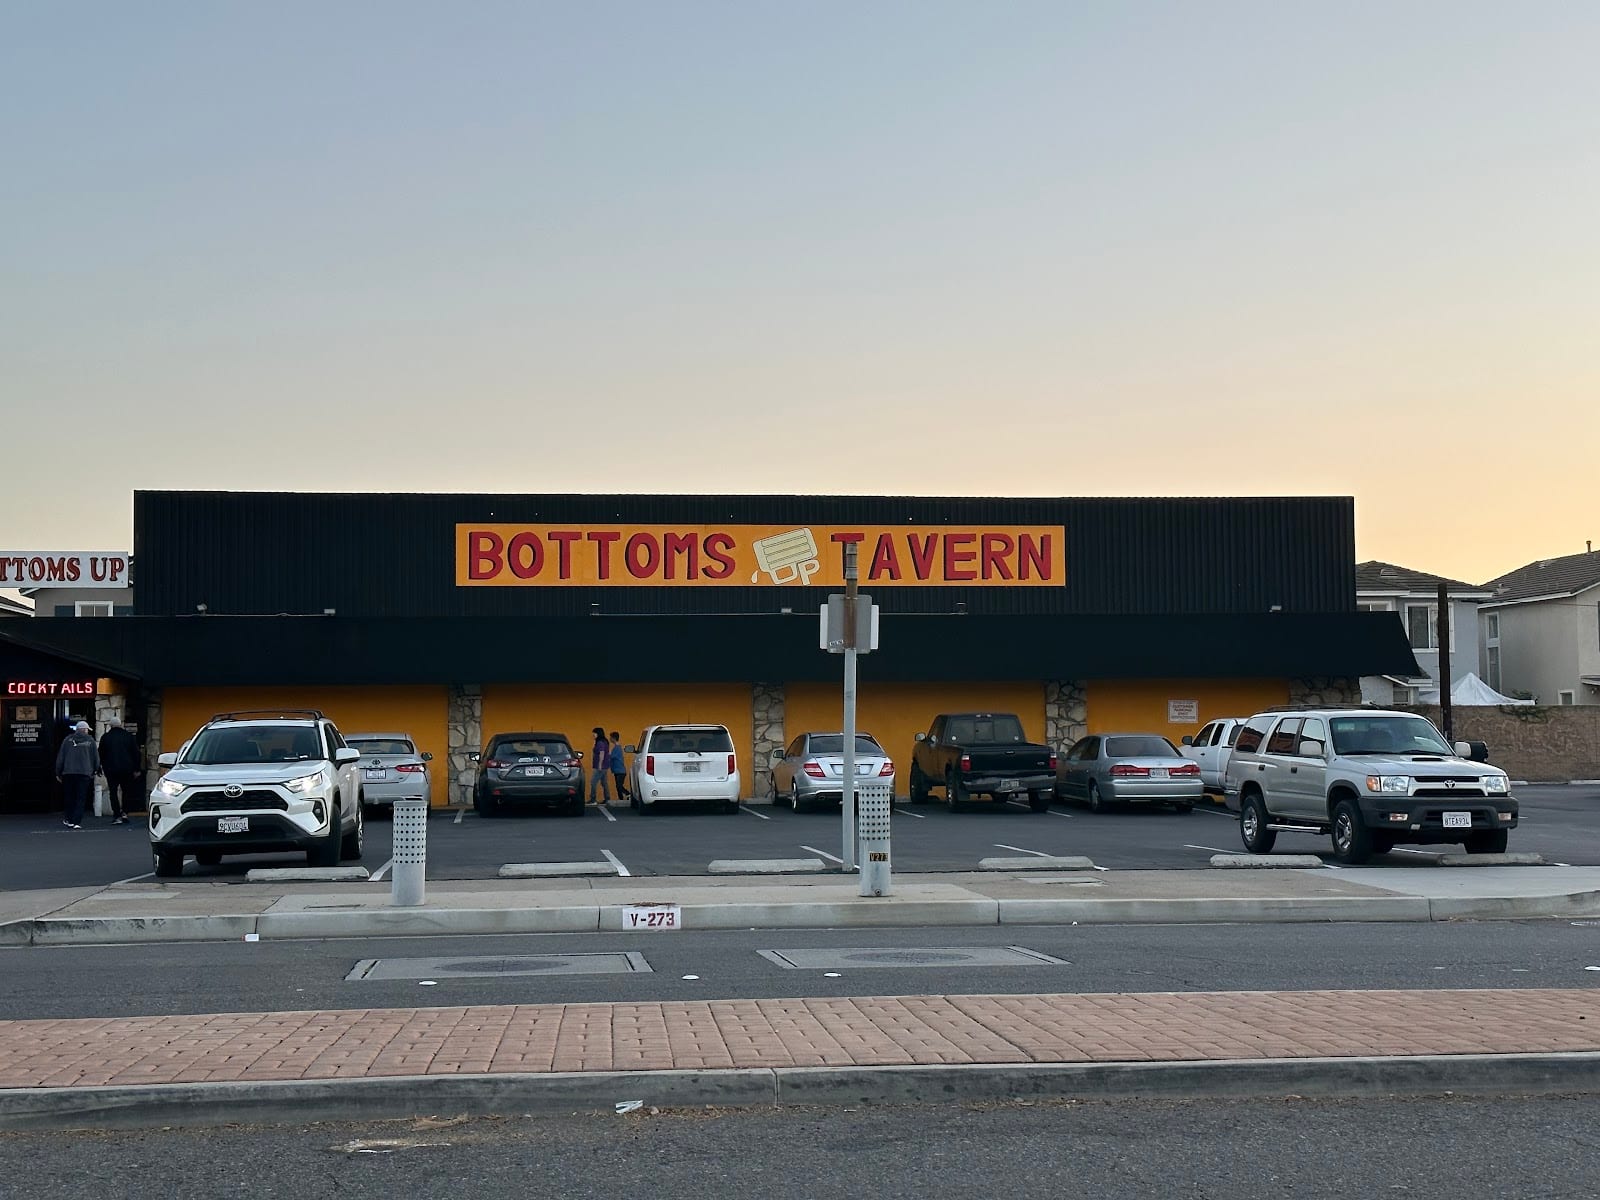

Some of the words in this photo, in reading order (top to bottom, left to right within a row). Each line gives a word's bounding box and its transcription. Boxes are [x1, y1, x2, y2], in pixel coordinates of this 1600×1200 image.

[469, 531, 736, 580] BOTTOMS
[831, 532, 1052, 580] TAVERN
[90, 557, 125, 582] UP
[8, 682, 93, 694] COCKTAILS
[630, 912, 675, 927] V-273
